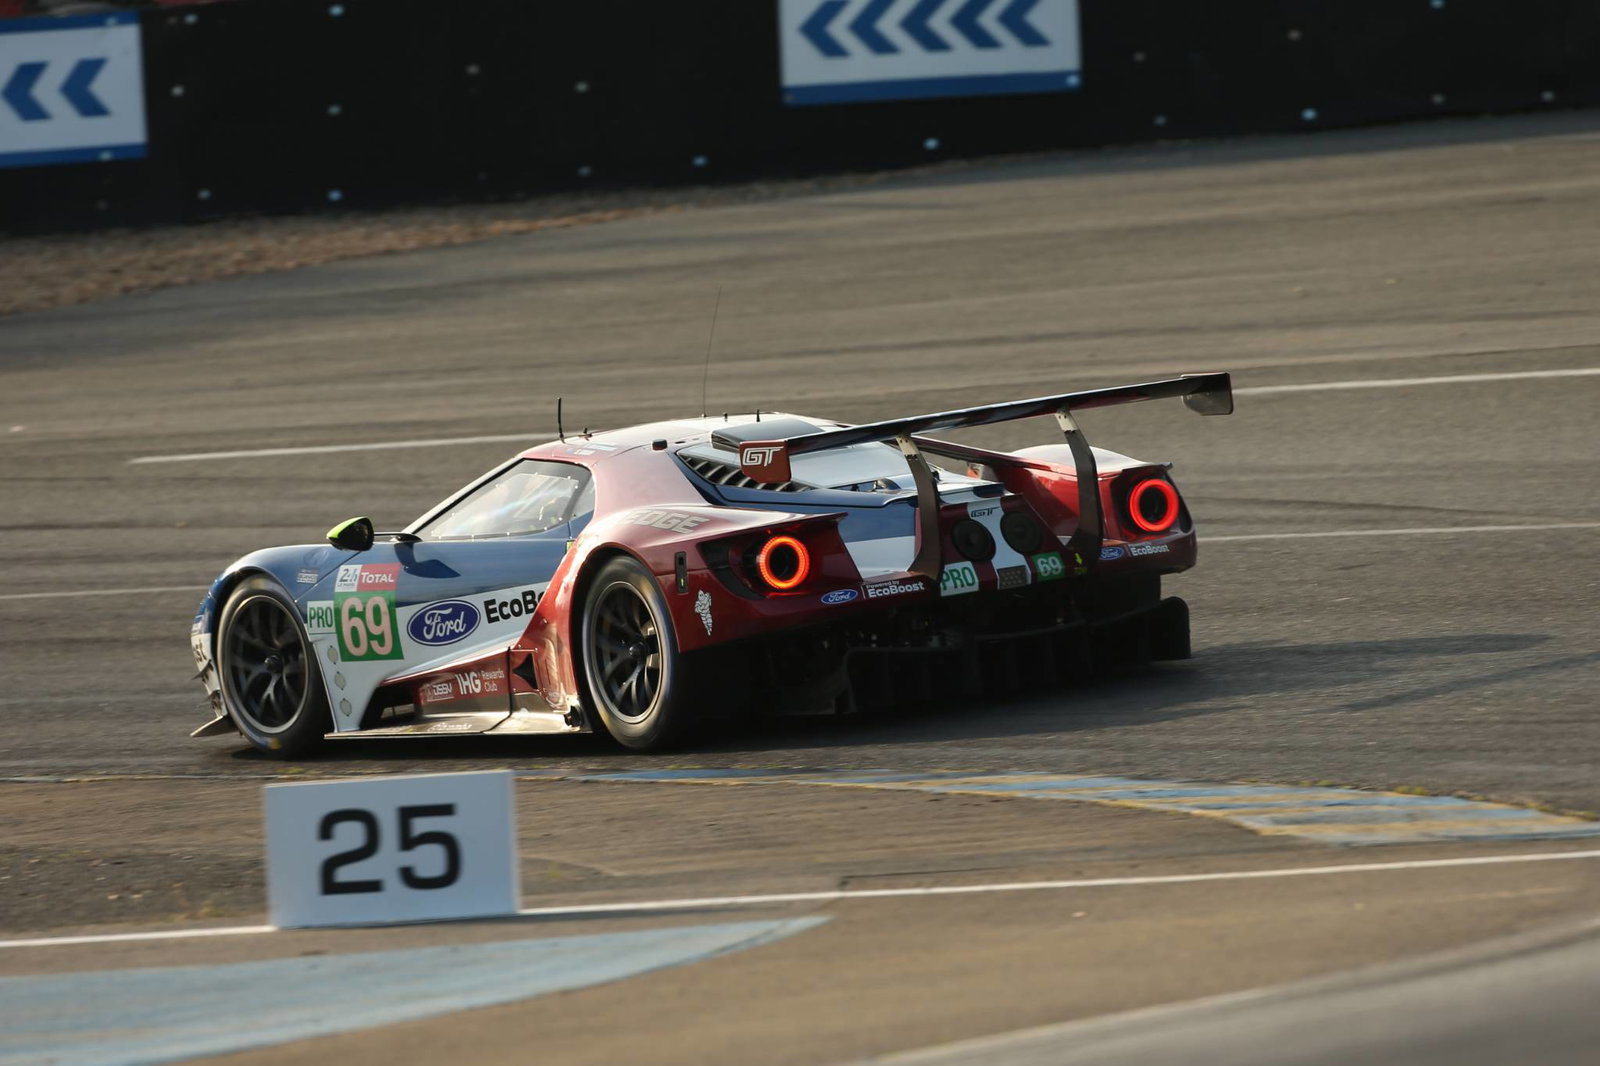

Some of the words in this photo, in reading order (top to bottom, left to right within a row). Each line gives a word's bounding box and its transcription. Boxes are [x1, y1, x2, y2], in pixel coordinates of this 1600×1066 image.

[743, 446, 784, 467] GT
[1130, 544, 1170, 557] EcoBoost
[1037, 556, 1061, 577] 69
[941, 566, 976, 591] PRO
[868, 581, 925, 598] EcoBoost
[309, 607, 333, 628] PRO
[484, 590, 545, 624] EcoB
[341, 596, 393, 657] 69
[423, 607, 467, 640] Ford
[455, 671, 481, 695] IHG
[481, 668, 505, 679] Rewards
[485, 681, 498, 692] Club
[318, 803, 463, 895] 25
